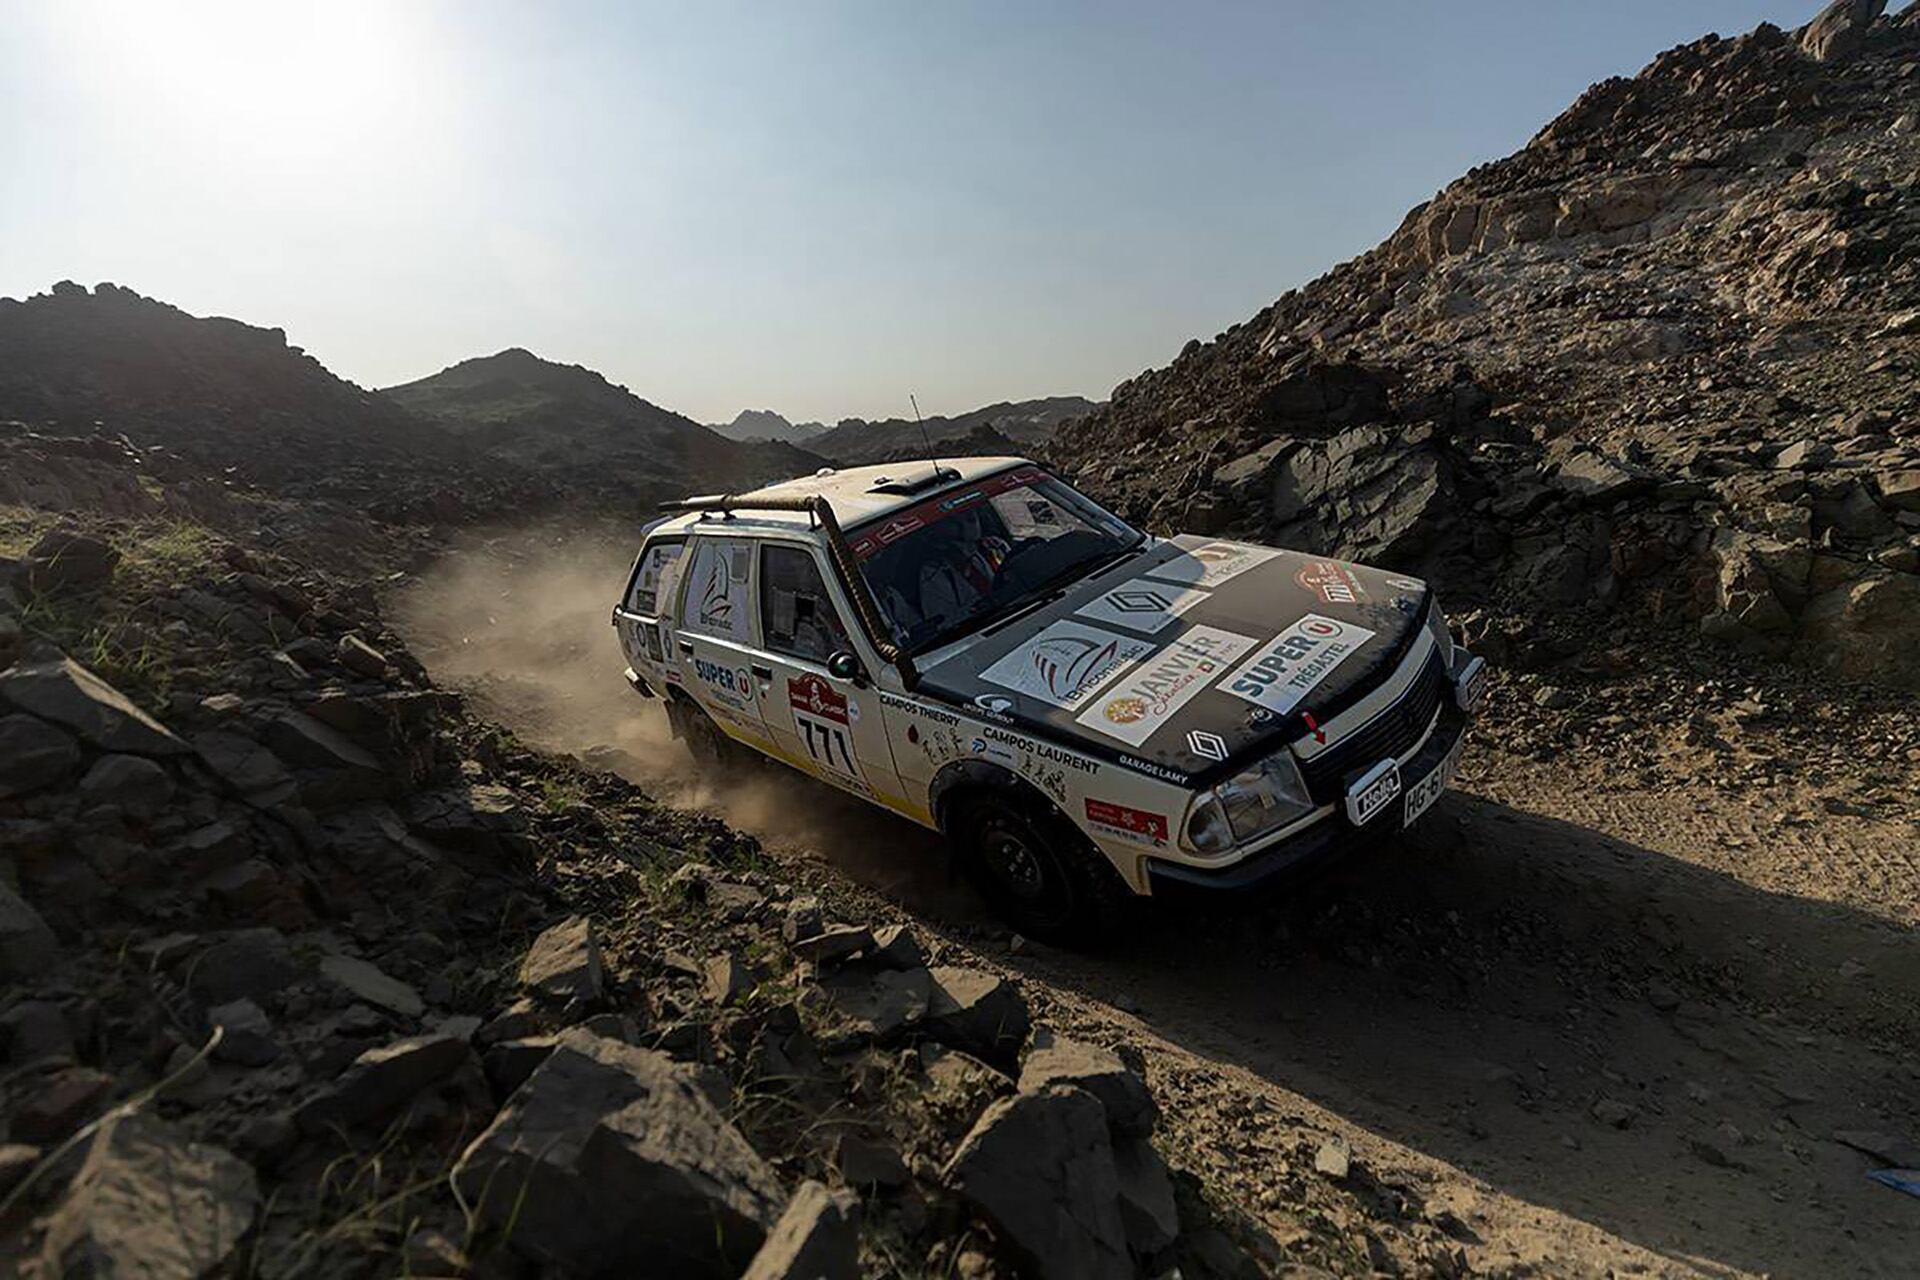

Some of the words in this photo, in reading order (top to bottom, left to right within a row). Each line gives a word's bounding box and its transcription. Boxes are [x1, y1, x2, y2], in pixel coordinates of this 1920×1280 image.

[695, 659, 736, 691] SUPER
[1131, 636, 1222, 704] JANVIER
[1232, 636, 1320, 698] SUPER
[879, 694, 918, 715] CAMPOS
[918, 706, 961, 727] THIERRY
[798, 717, 858, 776] 771
[983, 726, 1035, 753] CAMPOS
[1036, 742, 1101, 775] LAURENT
